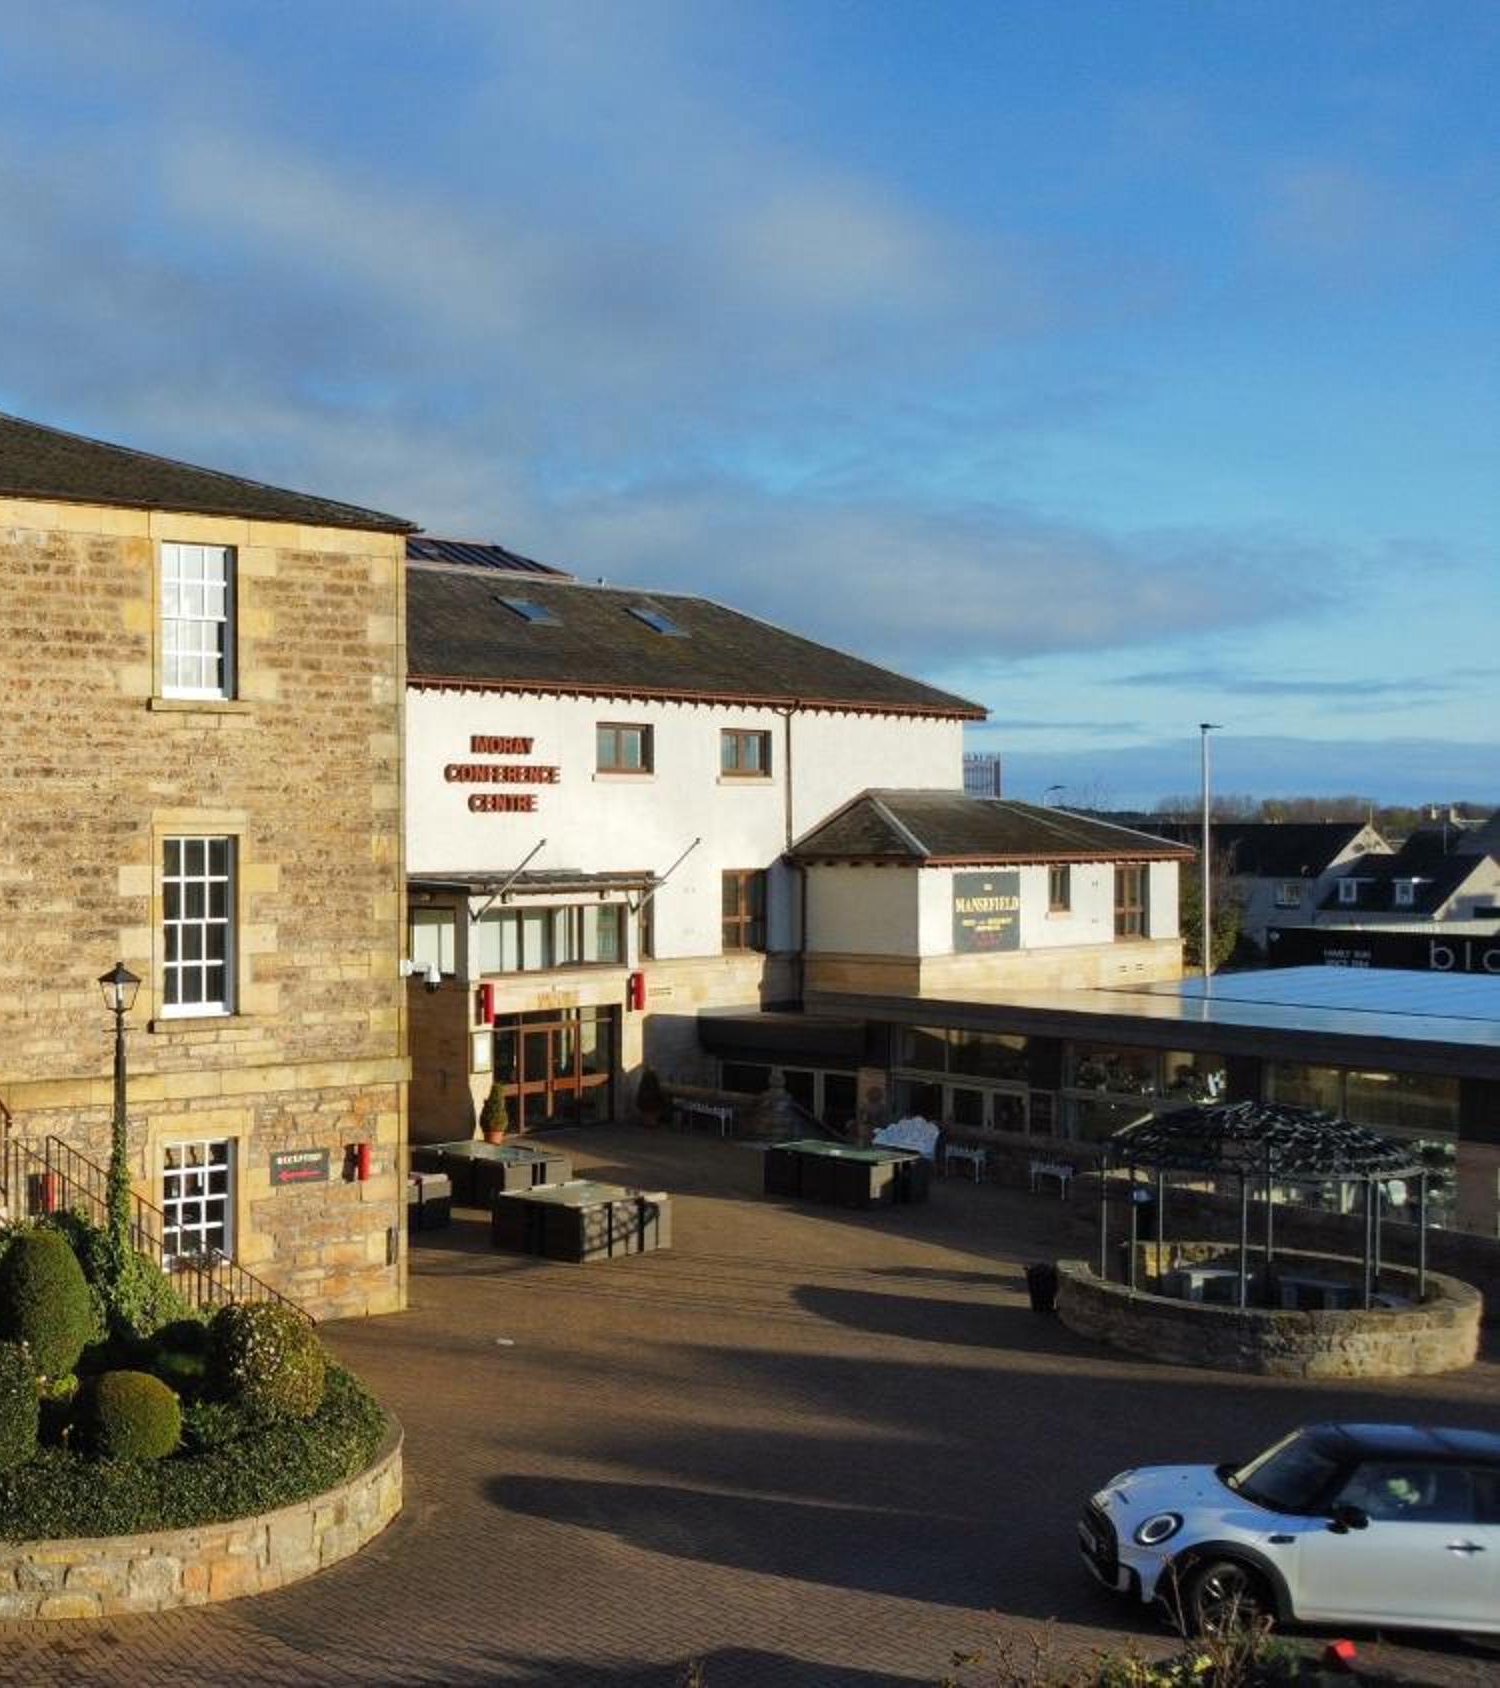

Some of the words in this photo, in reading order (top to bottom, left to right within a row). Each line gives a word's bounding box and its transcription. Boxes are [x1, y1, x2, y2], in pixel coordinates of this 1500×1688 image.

[470, 734, 535, 754] MORAY
[443, 763, 561, 784] CONFERENCE
[467, 793, 539, 813] CENTRE
[955, 896, 1019, 912] MANSEFIELD
